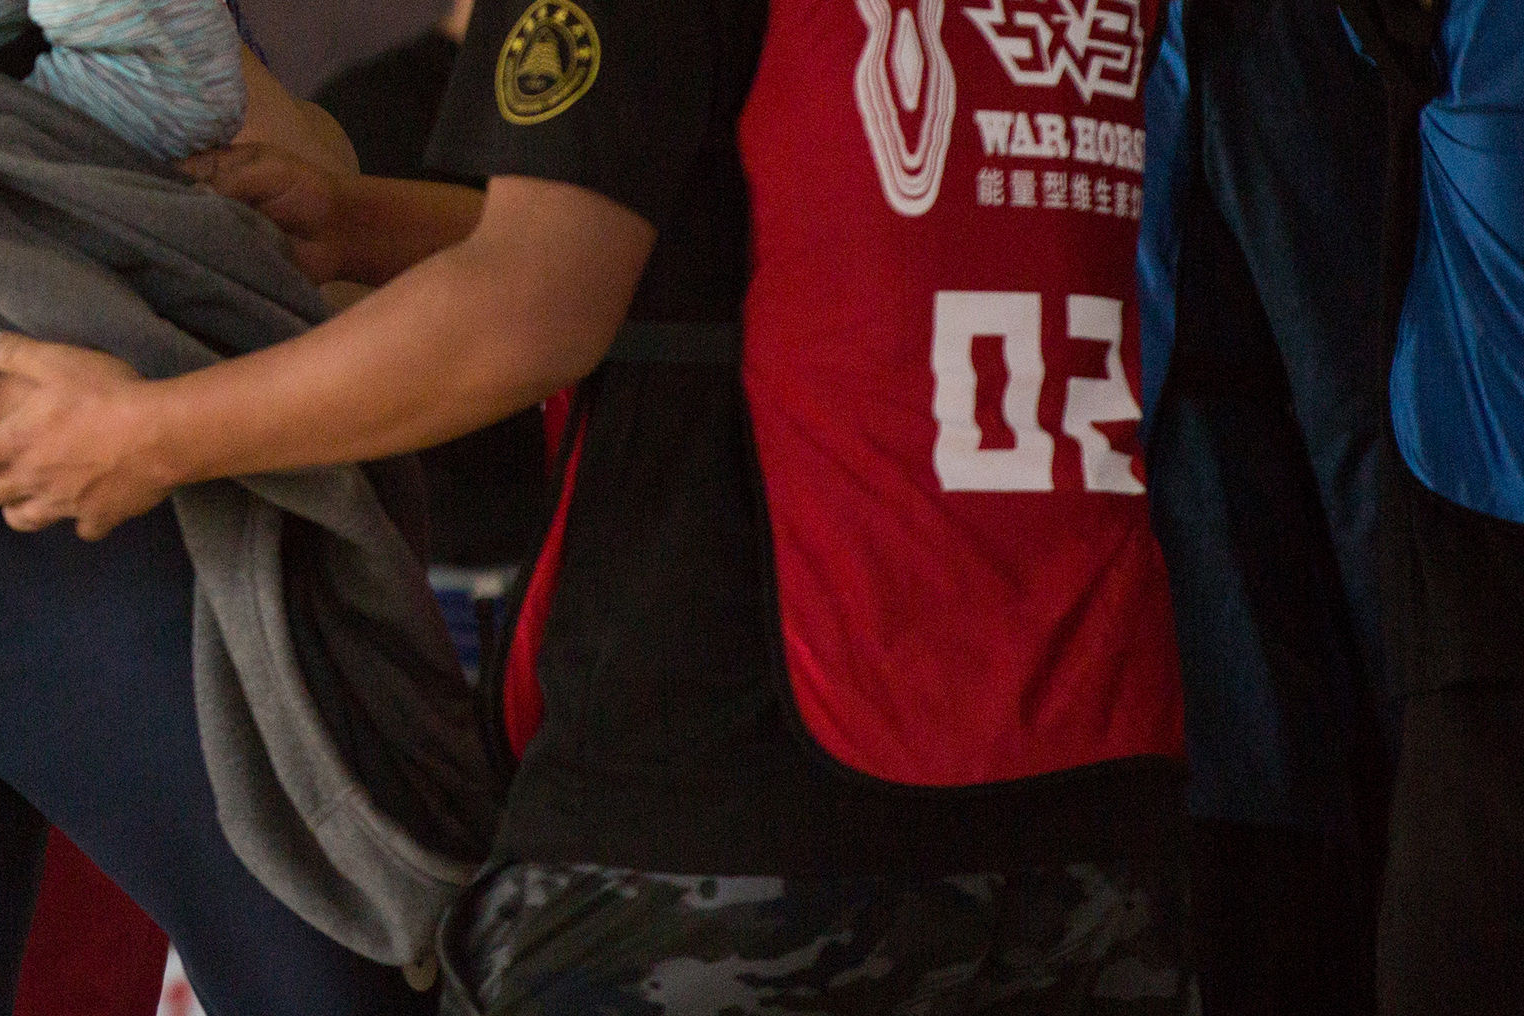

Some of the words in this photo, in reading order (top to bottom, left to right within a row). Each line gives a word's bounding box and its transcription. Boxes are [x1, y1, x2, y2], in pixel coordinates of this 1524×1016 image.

[973, 109, 1071, 159] WAR
[1071, 115, 1146, 174] HORS
[930, 290, 1147, 495] 02
